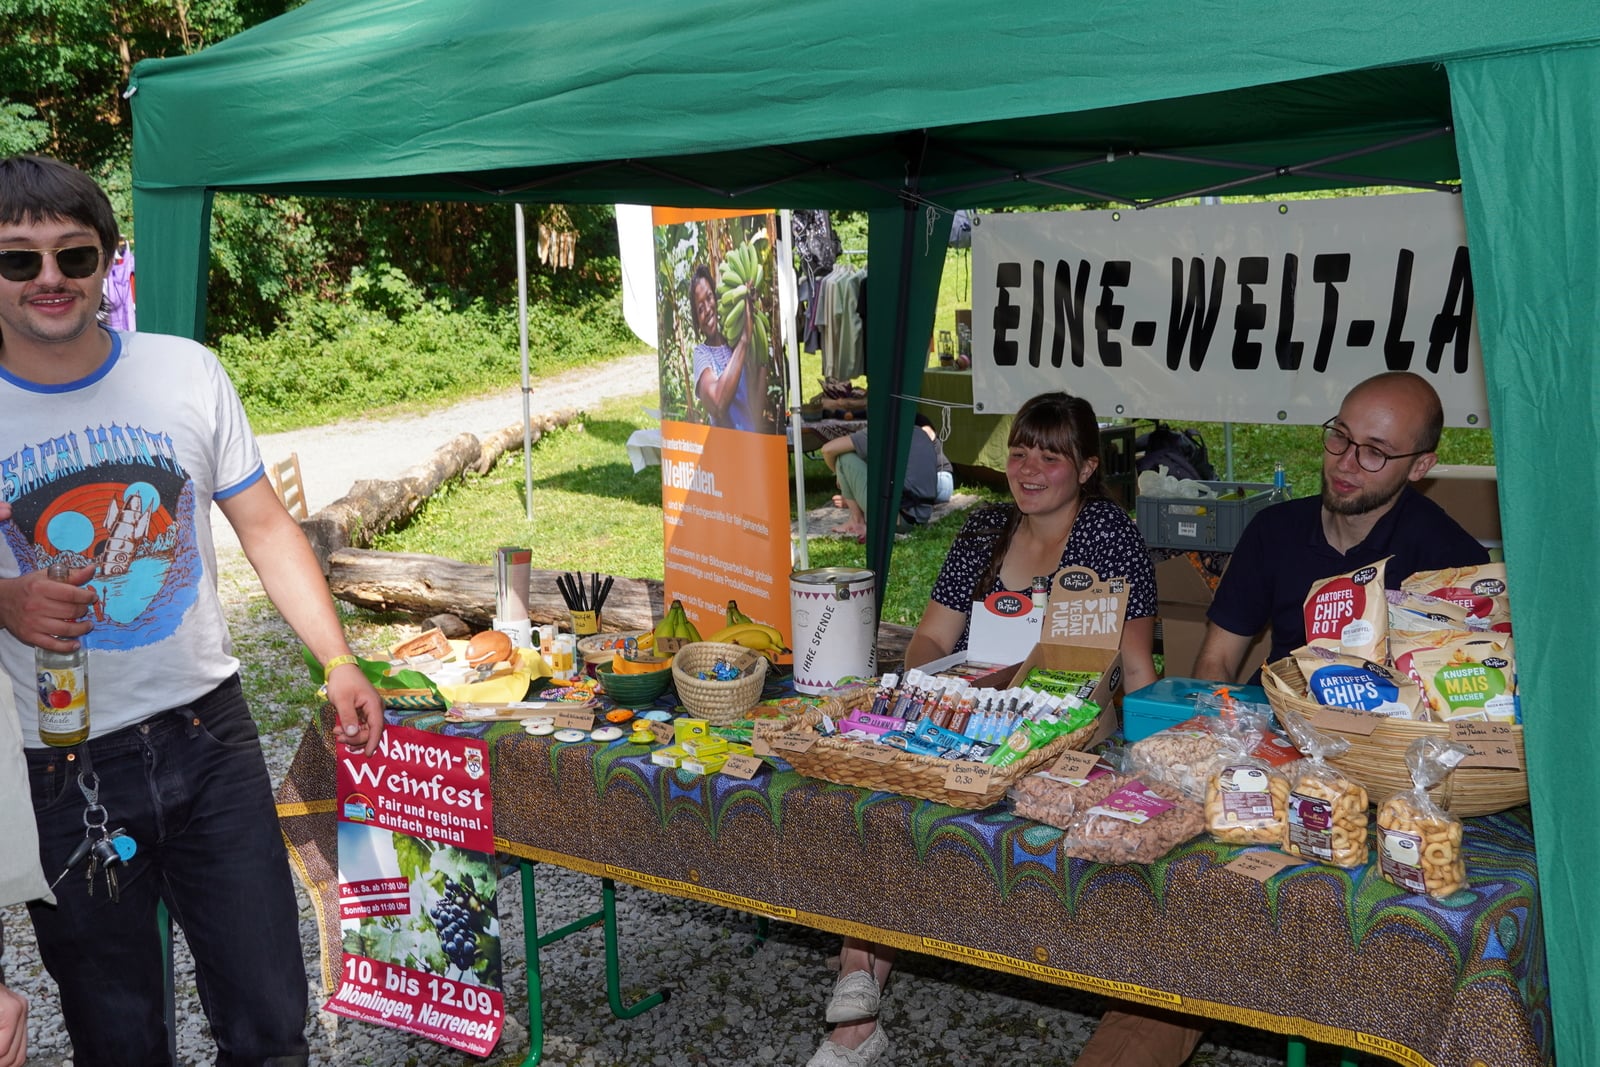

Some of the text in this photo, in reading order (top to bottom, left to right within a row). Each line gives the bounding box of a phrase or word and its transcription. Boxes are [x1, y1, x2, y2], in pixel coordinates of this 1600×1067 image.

[0, 430, 87, 503] SACRI
[709, 554, 743, 575] Bildungsarbeit
[1099, 596, 1119, 613] BIO
[1316, 588, 1354, 603] KARTOFFEL
[1051, 601, 1070, 637] PURE
[1069, 599, 1083, 636] VEGAN
[1314, 600, 1354, 621] CHIPS
[1312, 619, 1339, 634] ROT
[802, 604, 835, 673] IHRE SPENDE
[1319, 674, 1374, 688] KARTOFFEL
[1443, 667, 1486, 679] KNUSPER
[1323, 681, 1379, 706] CHIPS
[1444, 676, 1489, 695] MAIS
[1448, 692, 1485, 702] KRACHER
[343, 758, 485, 811] Weinfest
[954, 775, 973, 785] 0,30
[378, 795, 401, 809] Fair
[403, 803, 425, 818] und
[427, 810, 481, 831] regional
[379, 813, 423, 834] einfach
[425, 823, 465, 843] genial
[372, 883, 380, 892] ab
[396, 881, 407, 890] Uhr
[343, 905, 372, 915] Sonntag
[372, 904, 380, 912] ab
[396, 902, 407, 910] Uhr
[924, 938, 966, 954] VERITABLE
[967, 948, 986, 959] REAL
[986, 952, 1006, 962] WAX
[1037, 966, 1070, 979] CHAVDA
[1070, 973, 1111, 989] TANZANIA
[345, 957, 500, 1019] 10. bis 12.09.
[335, 981, 497, 1043] Mömlingen, Narreneck
[1361, 1034, 1410, 1055] VERITABLE
